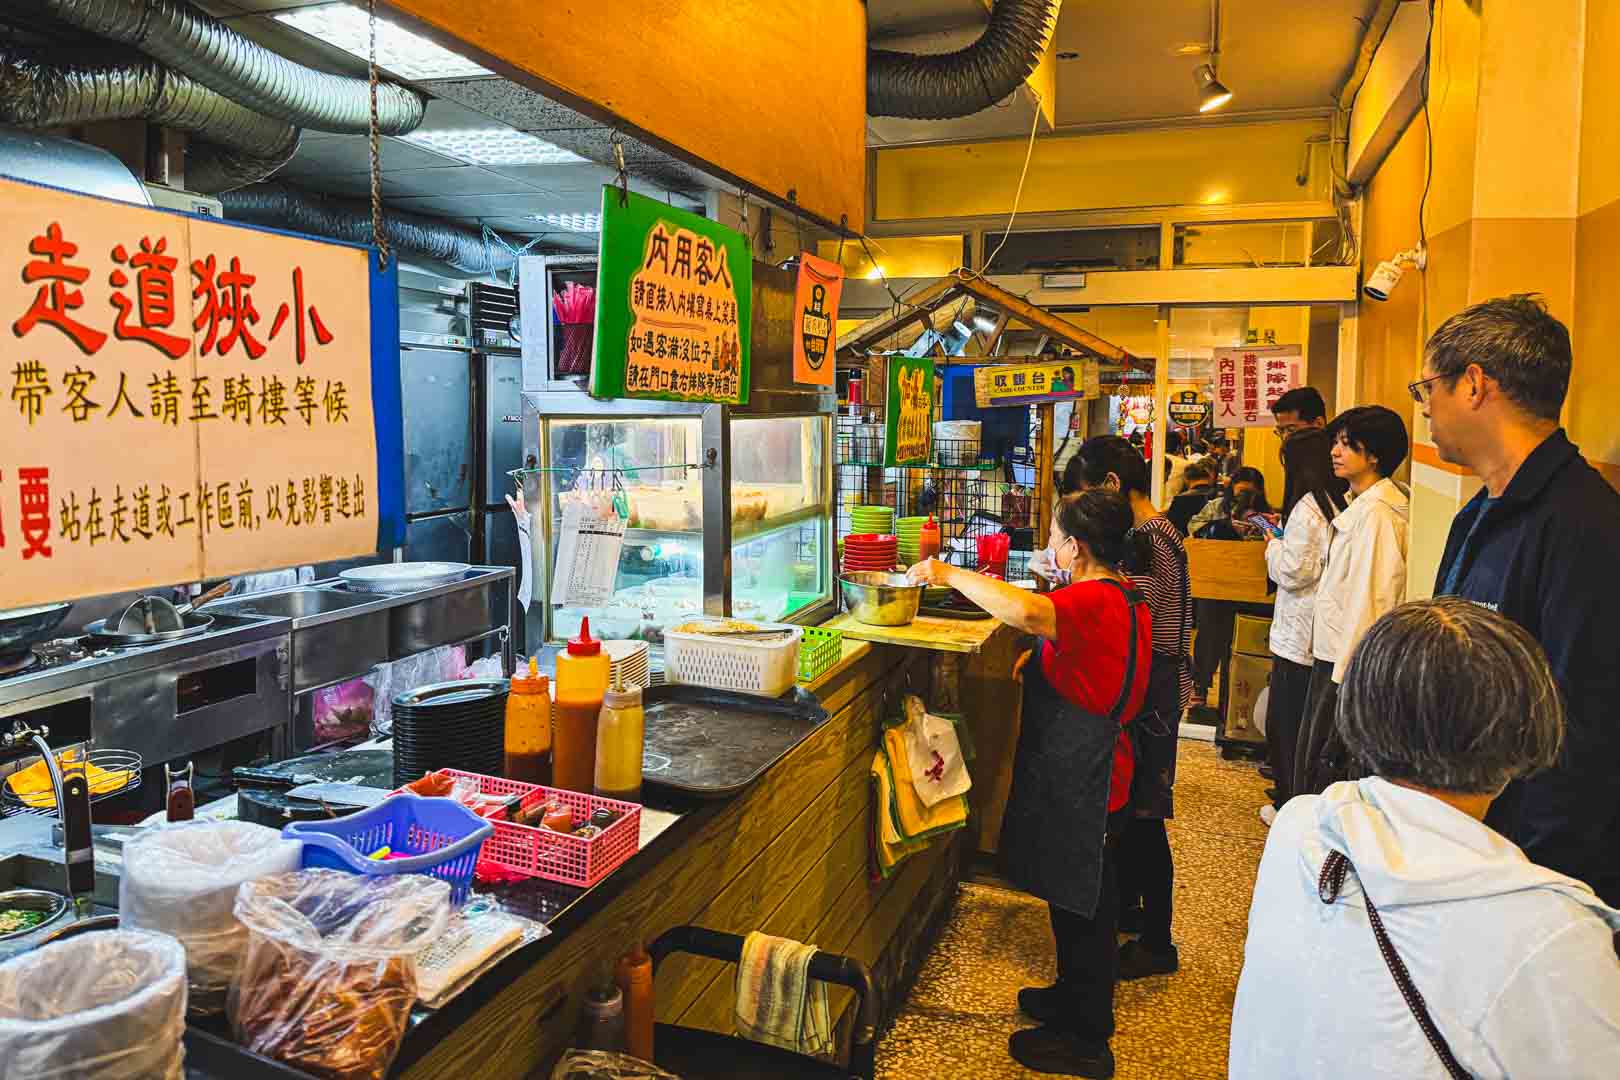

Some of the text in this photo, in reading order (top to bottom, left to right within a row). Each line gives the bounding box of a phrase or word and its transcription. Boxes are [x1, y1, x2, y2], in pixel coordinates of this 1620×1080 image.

[646, 227, 731, 288] 內用客人
[12, 221, 334, 364] 走道狹小
[11, 359, 350, 426] 帶客人請至騎樓等候
[1219, 358, 1236, 417] 內用客人
